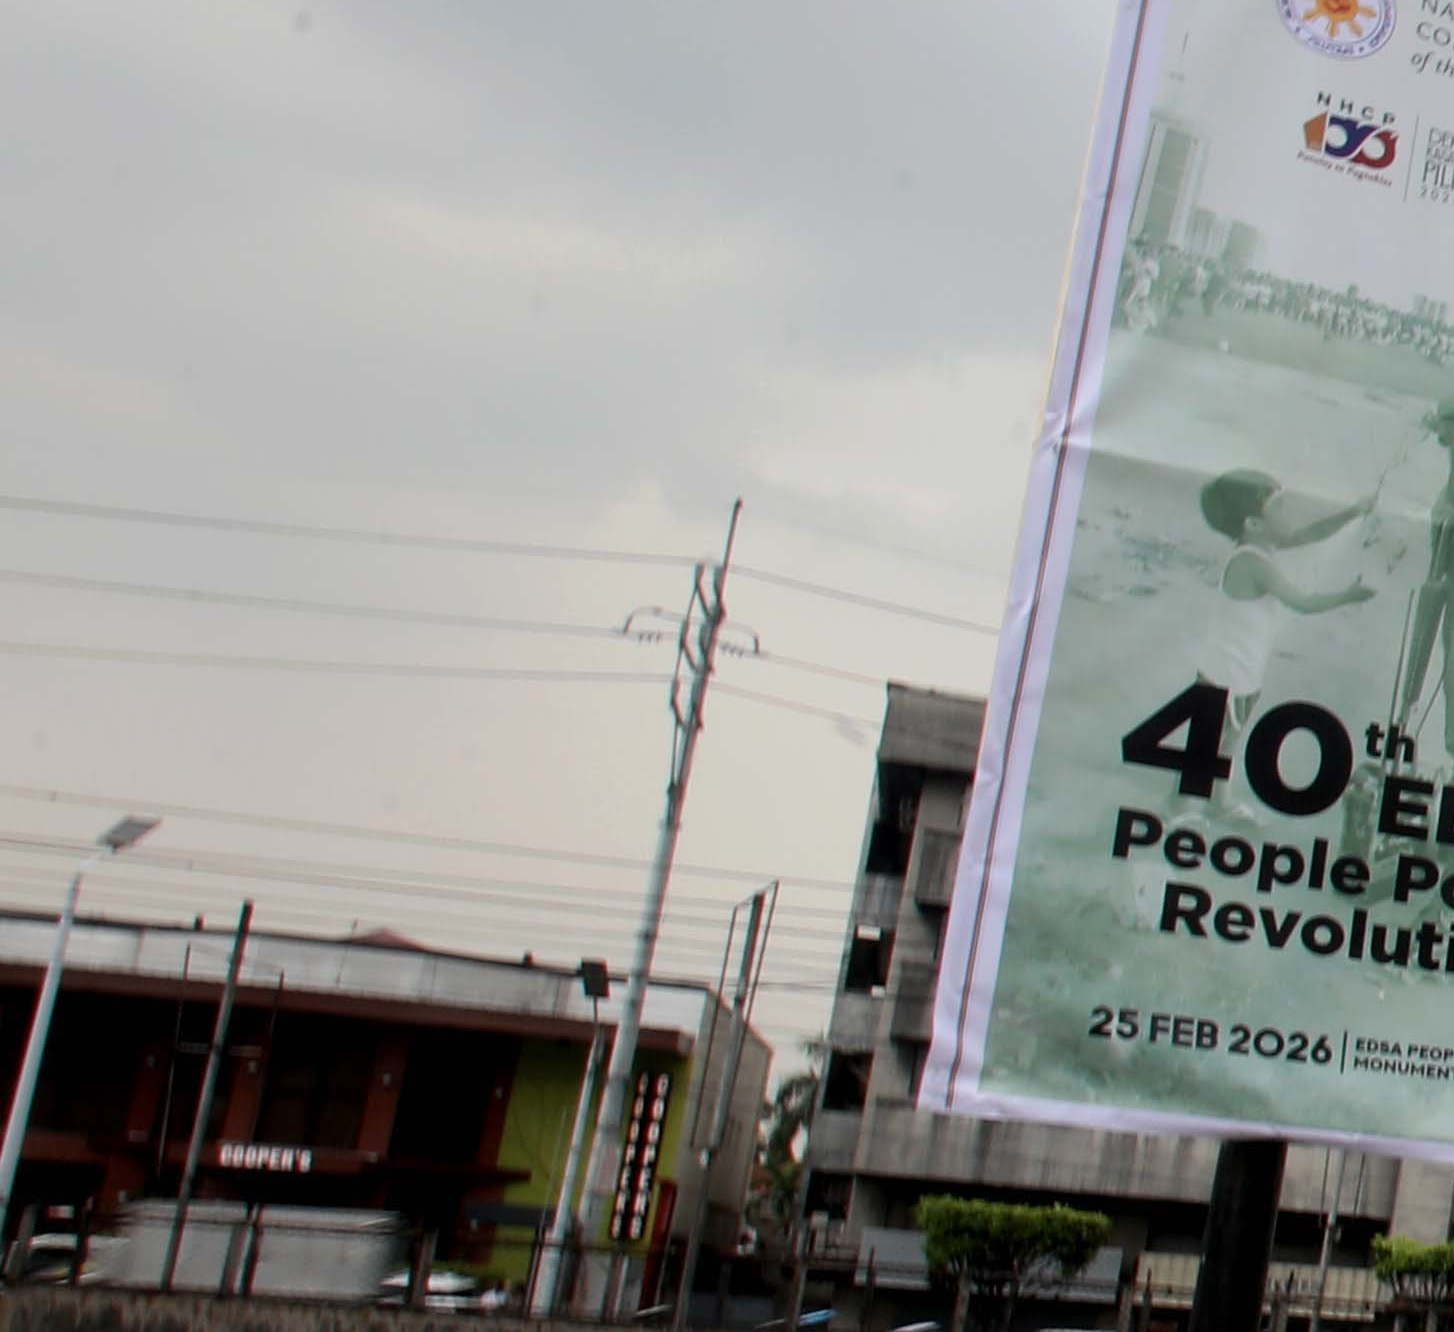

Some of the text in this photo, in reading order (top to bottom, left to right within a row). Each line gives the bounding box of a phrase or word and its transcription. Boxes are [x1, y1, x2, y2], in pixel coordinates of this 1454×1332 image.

[1410, 50, 1436, 74] of
[1112, 807, 1371, 896] People
[1088, 1004, 1333, 1065] 25 FEB 2026
[1355, 1036, 1402, 1055] EDSA
